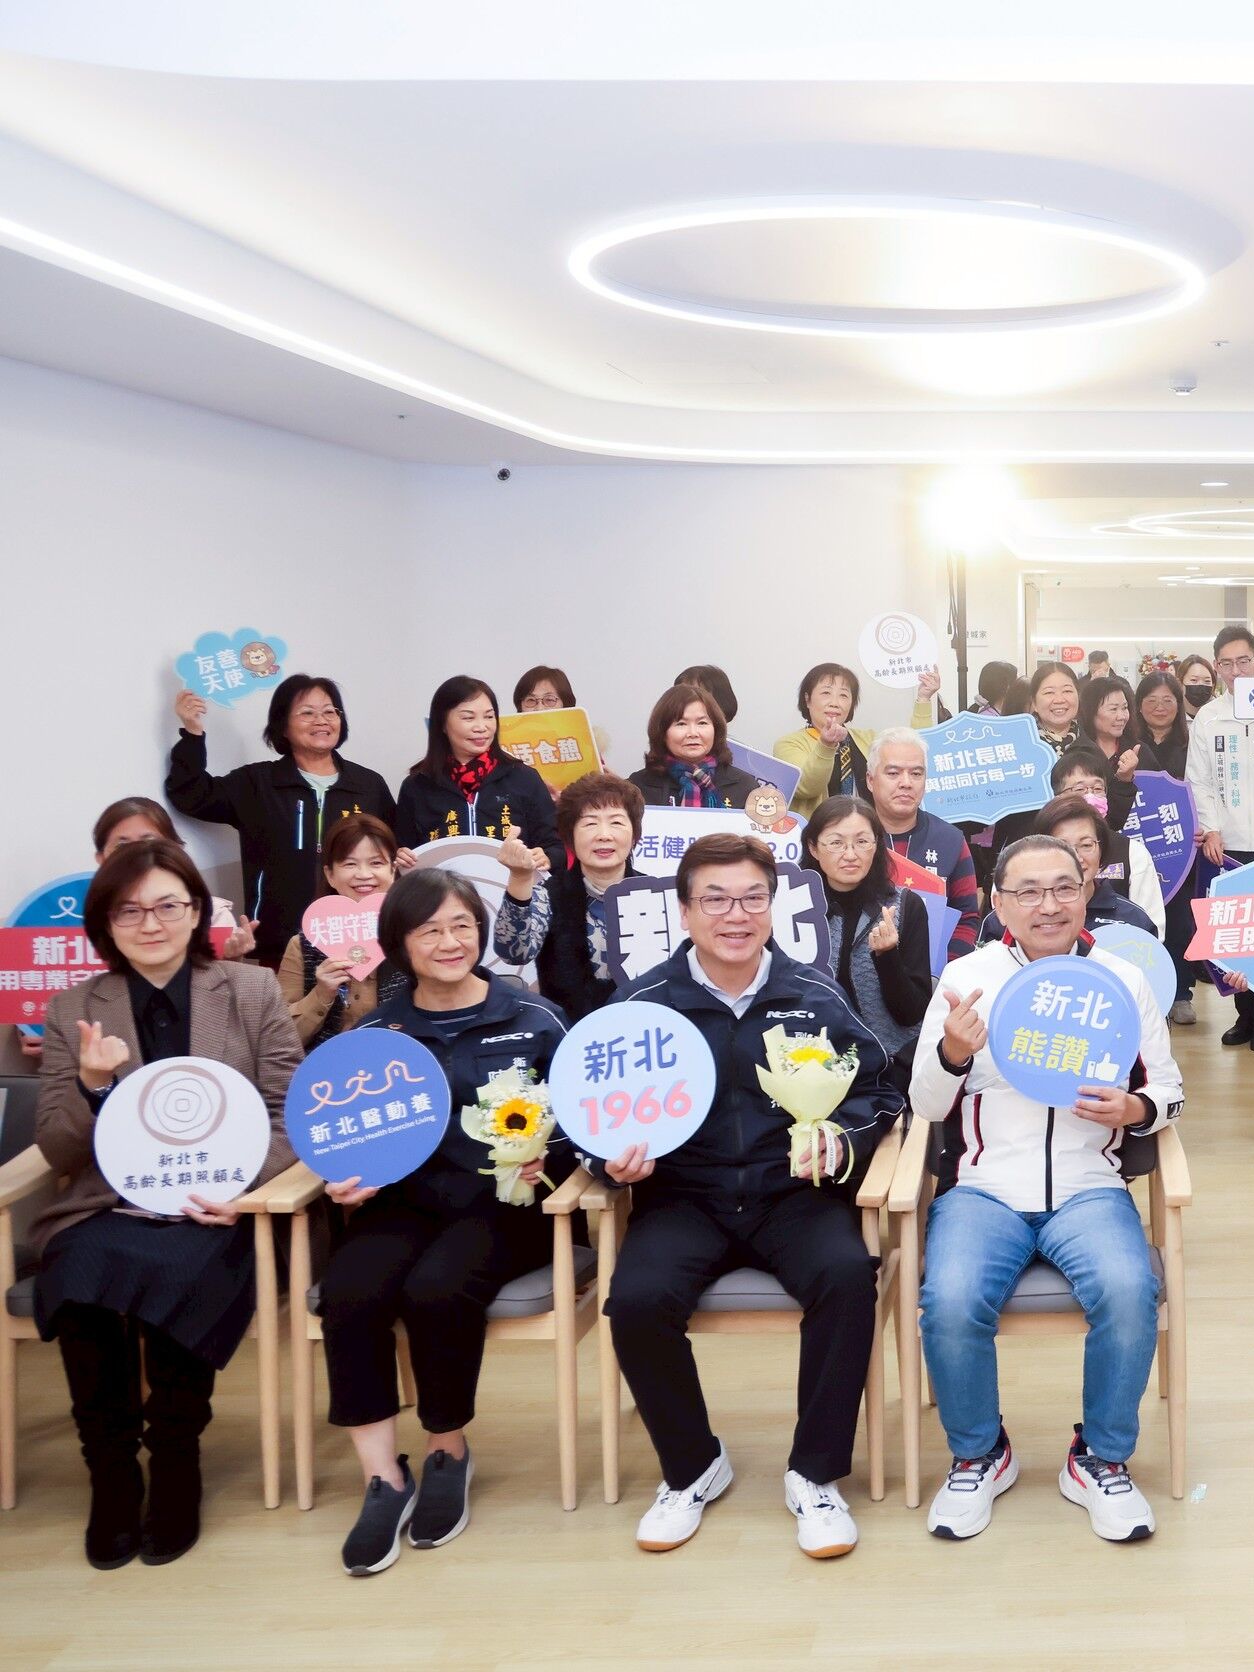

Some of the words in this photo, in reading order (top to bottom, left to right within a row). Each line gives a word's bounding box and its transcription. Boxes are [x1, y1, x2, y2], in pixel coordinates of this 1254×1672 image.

[194, 649, 239, 675] 友善
[202, 669, 246, 695] 天使
[933, 743, 1018, 773] 新北長照
[925, 762, 1035, 794] 與您同行每一步
[310, 911, 380, 948] 失智守護
[1030, 979, 1113, 1030] 新北
[583, 1027, 678, 1085] 新北
[1007, 1026, 1090, 1076] 熊讚
[309, 1092, 432, 1144] 新北醫動養
[579, 1080, 693, 1136] 1966
[314, 1145, 331, 1156] New
[330, 1140, 350, 1152] Taipei
[350, 1136, 365, 1147] City
[364, 1129, 388, 1142] Health
[387, 1121, 416, 1134] Exercise
[415, 1114, 436, 1126] Living
[158, 1151, 209, 1168] 新北市
[123, 1167, 247, 1191] 高齡長期照顧處
